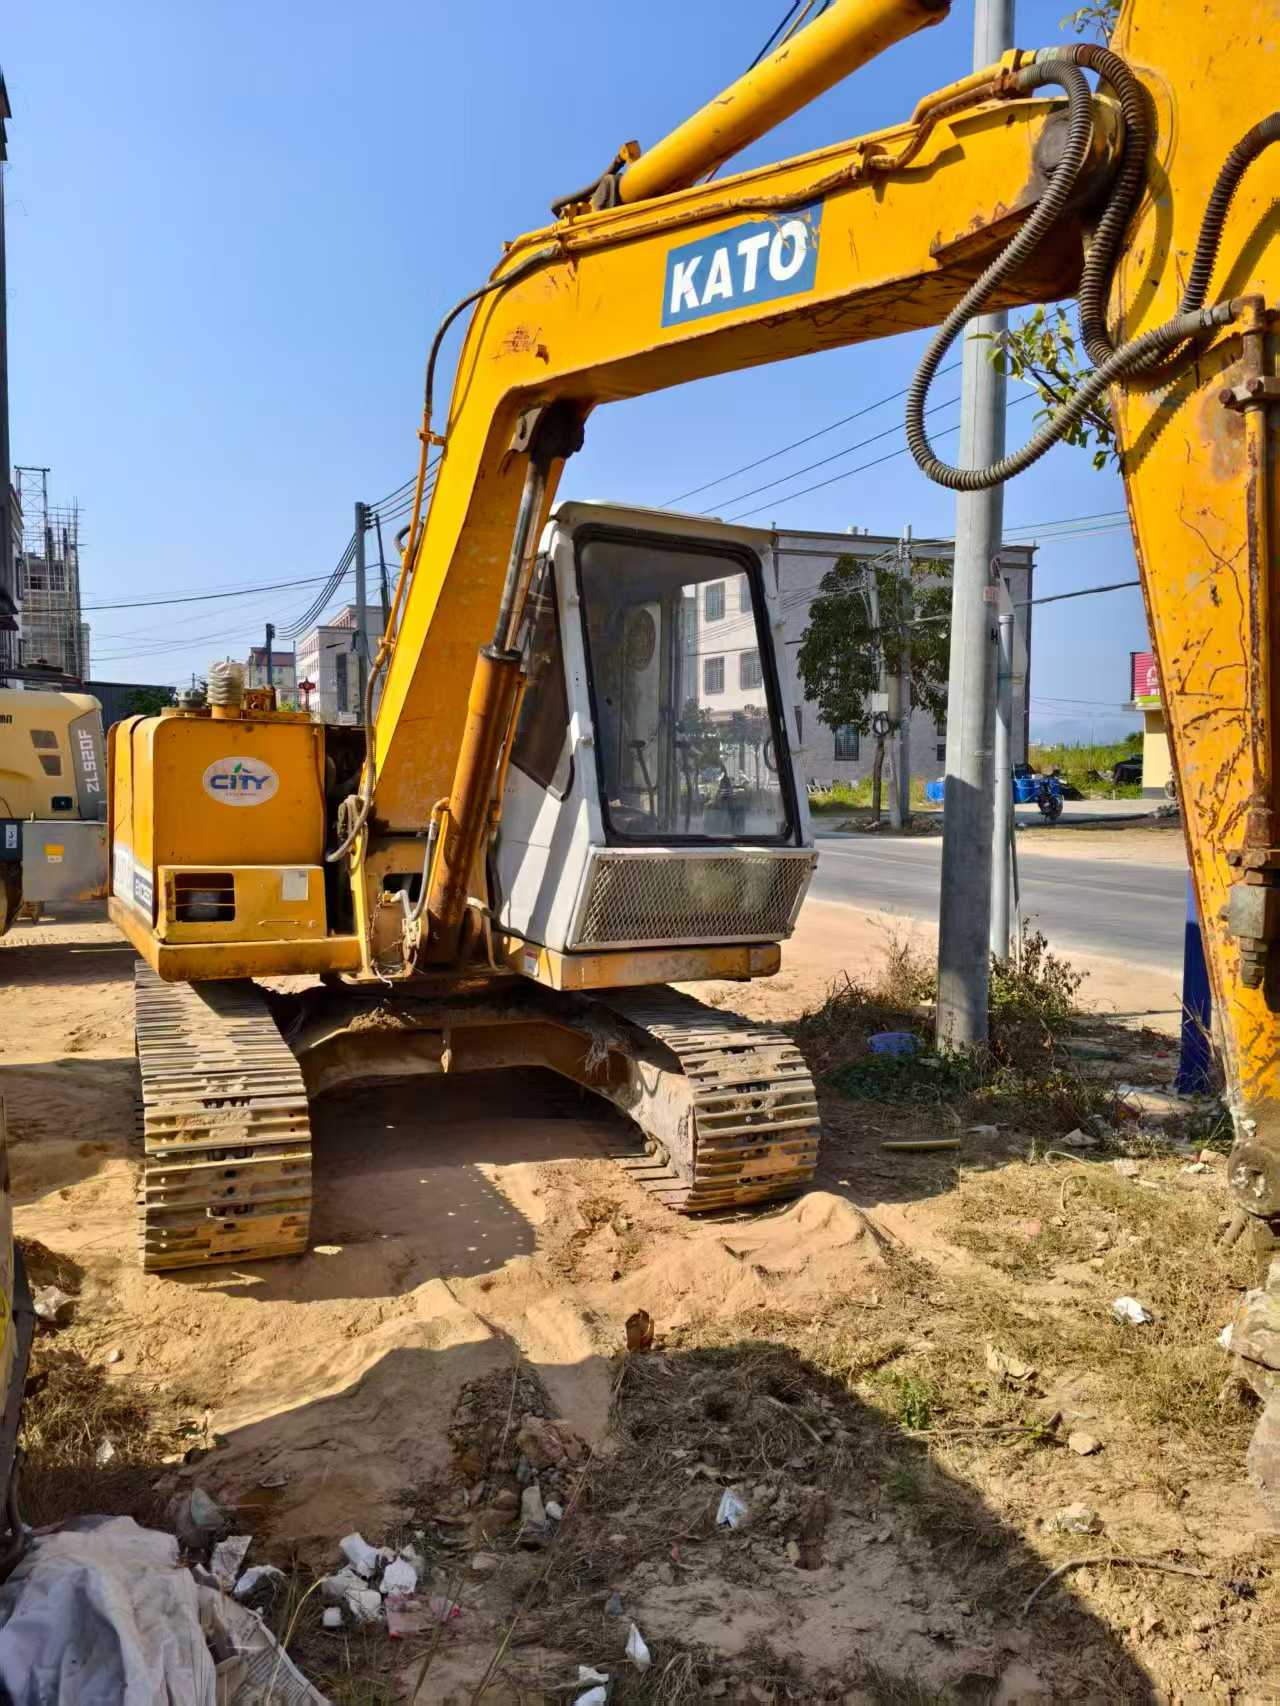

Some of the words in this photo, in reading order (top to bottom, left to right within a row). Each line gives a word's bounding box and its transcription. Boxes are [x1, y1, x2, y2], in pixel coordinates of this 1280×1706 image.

[670, 220, 809, 314] KATO
[78, 730, 100, 793] ZL920F
[210, 768, 271, 790] CITY
